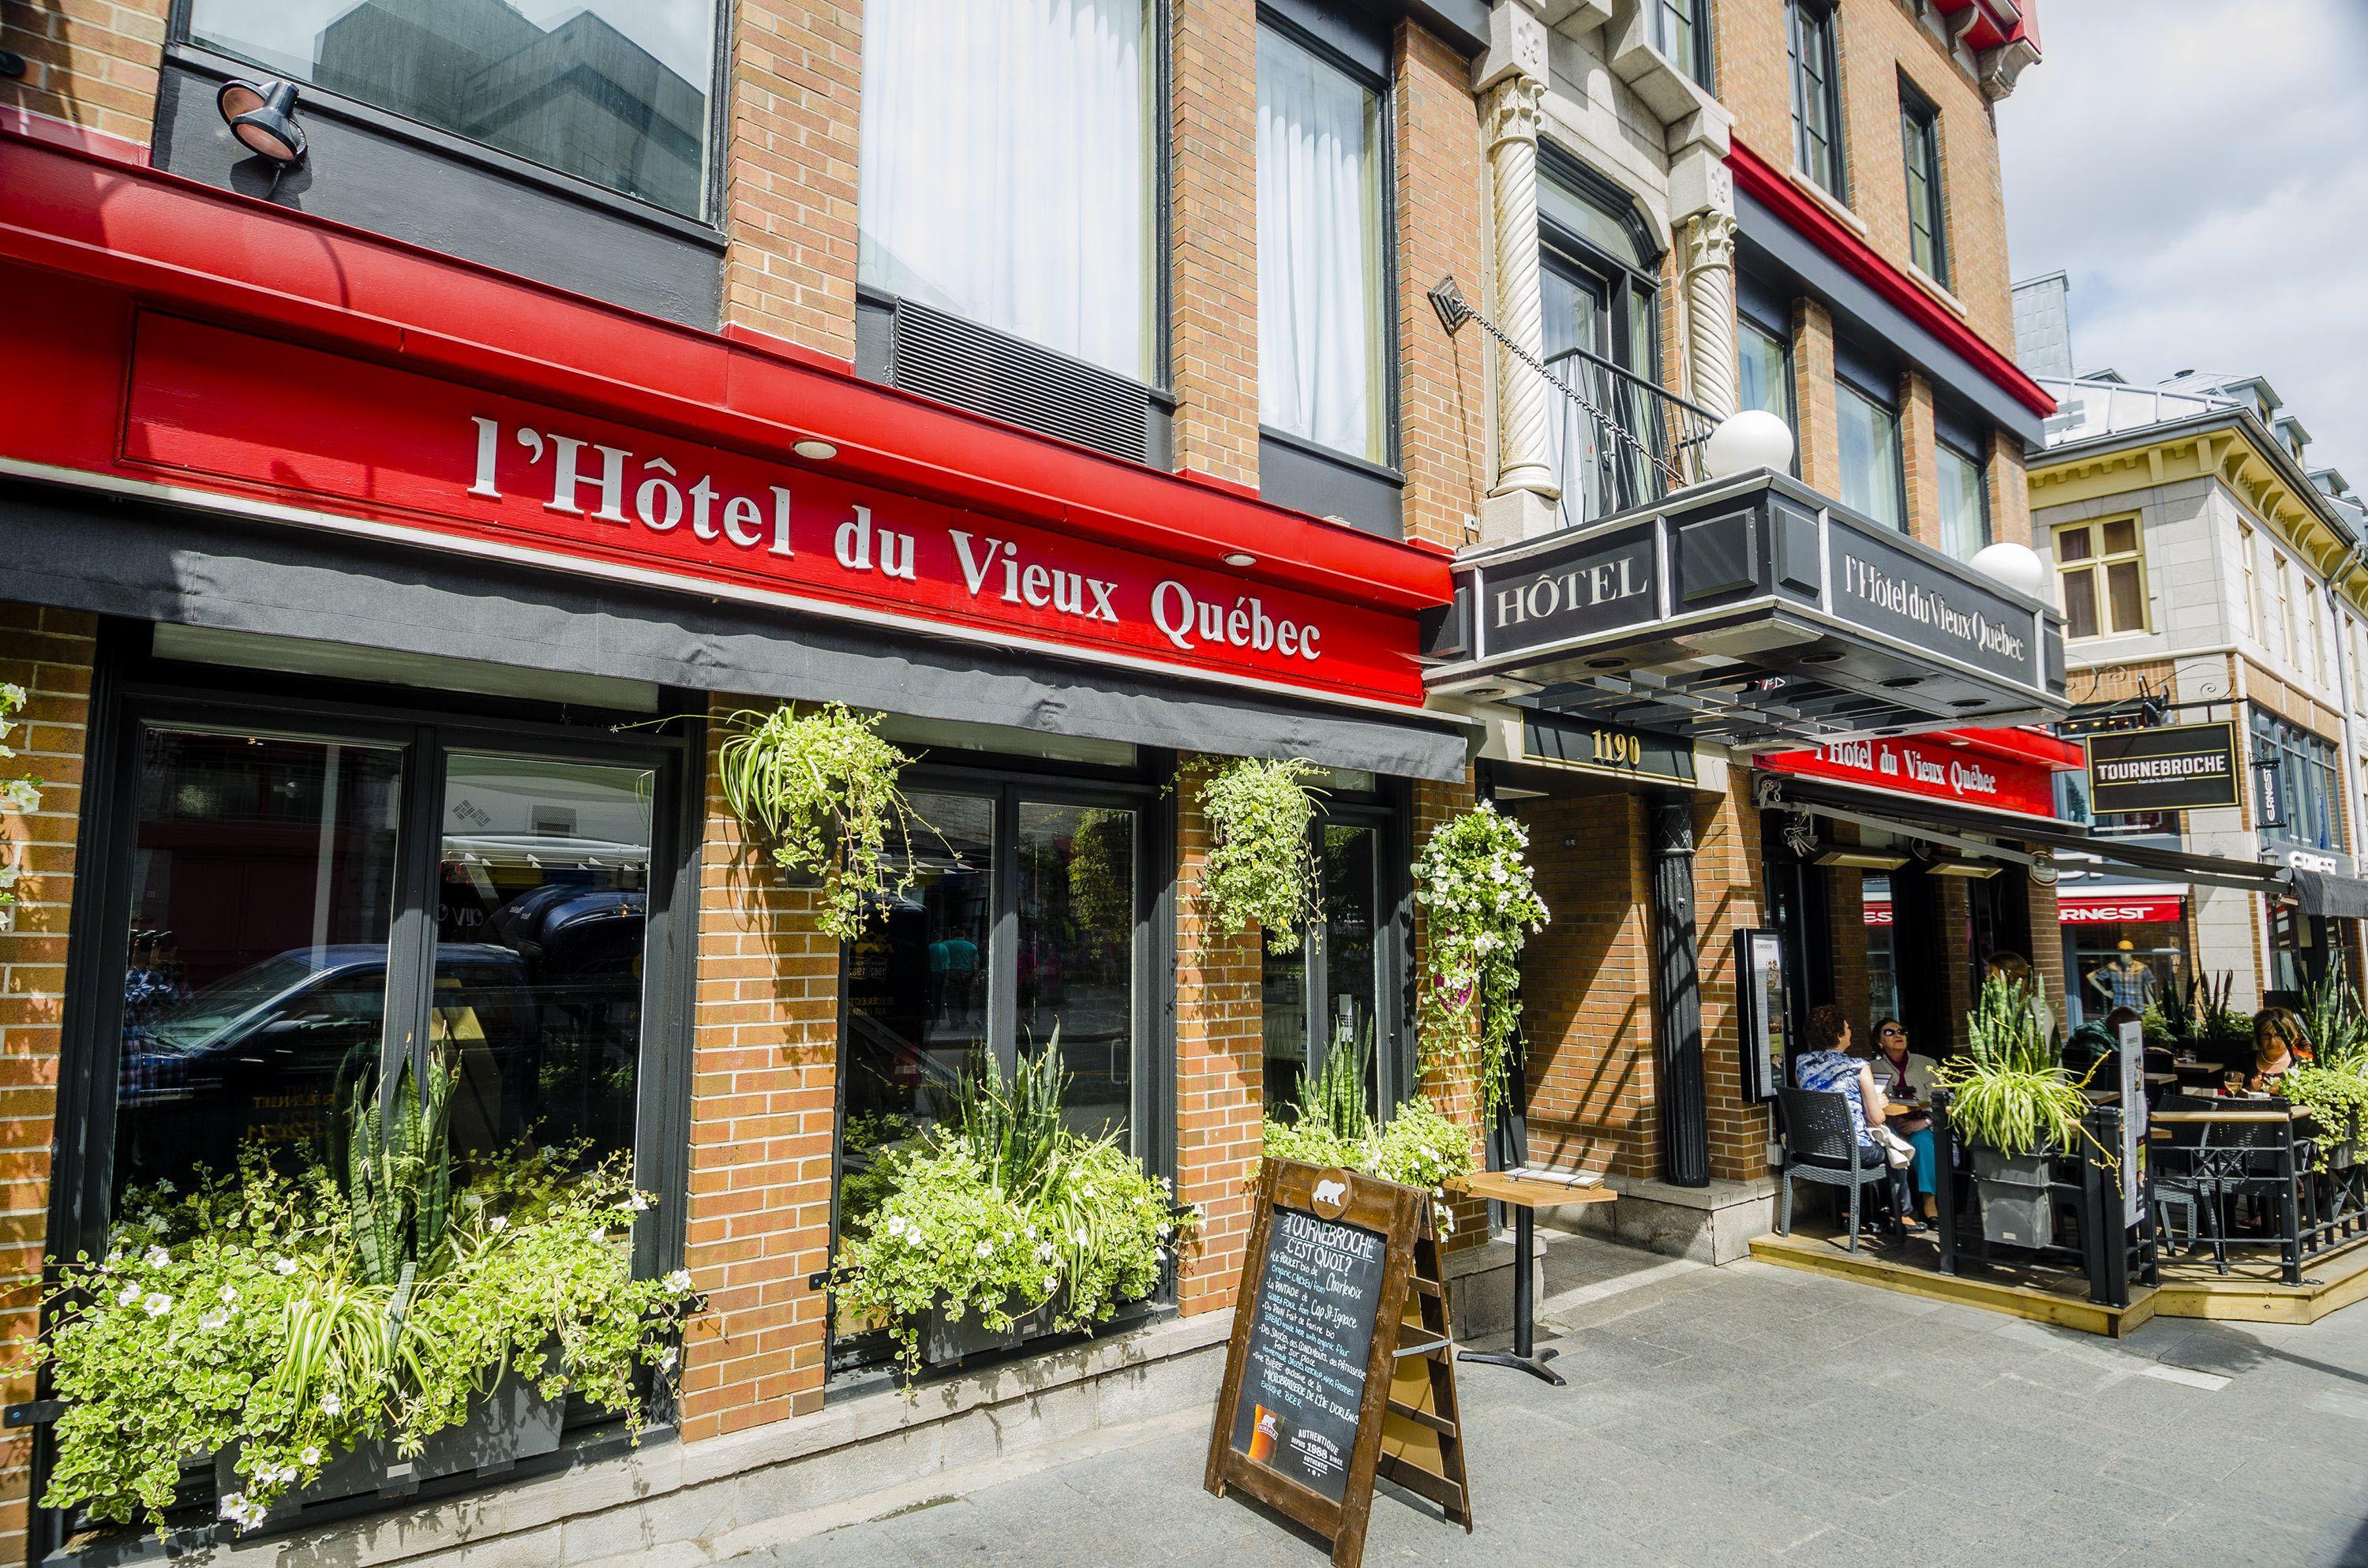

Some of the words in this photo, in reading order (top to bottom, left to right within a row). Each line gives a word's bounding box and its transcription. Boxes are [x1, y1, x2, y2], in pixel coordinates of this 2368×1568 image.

[467, 416, 795, 556] l'Hôtel
[834, 504, 916, 580] du
[948, 528, 1119, 623] Vieux
[1150, 580, 1321, 661] Québec
[1494, 557, 1647, 628] HÔTEL
[1845, 552, 1907, 615] l'Hôtel
[1909, 584, 1930, 623] du
[1928, 589, 1973, 640] Vieux
[1973, 610, 2025, 661] Québec
[1591, 729, 1640, 765] 1190
[1879, 744, 1898, 776] du
[1904, 750, 1946, 785] Vieux
[1950, 761, 1996, 795] Québec
[2096, 755, 2226, 780] TOURNEBROCHE
[2263, 768, 2276, 821] ERNEST
[2058, 907, 2153, 920] RNEST
[1284, 1213, 1375, 1259] TOURNEBROCHE
[1287, 1238, 1314, 1260] C'EST
[1278, 1252, 1302, 1269] POULET
[1300, 1261, 1310, 1273] bio
[1311, 1266, 1317, 1276] de
[1326, 1272, 1362, 1299] Charlevoix
[1265, 1312, 1282, 1326] BREAD
[1276, 1282, 1299, 1297] PINTADE
[1302, 1293, 1308, 1301] de
[1311, 1300, 1325, 1321] Cap
[1273, 1304, 1285, 1316] PAIN
[1306, 1319, 1322, 1334] farine
[1326, 1328, 1335, 1339] bio
[1285, 1390, 1302, 1408] BEER
[1291, 1437, 1305, 1448] DEPUIS
[1307, 1443, 1327, 1459] 1988
[1298, 1429, 1339, 1455] AUTHENTIQUE
[1304, 1455, 1328, 1471] AUTHENTIC
